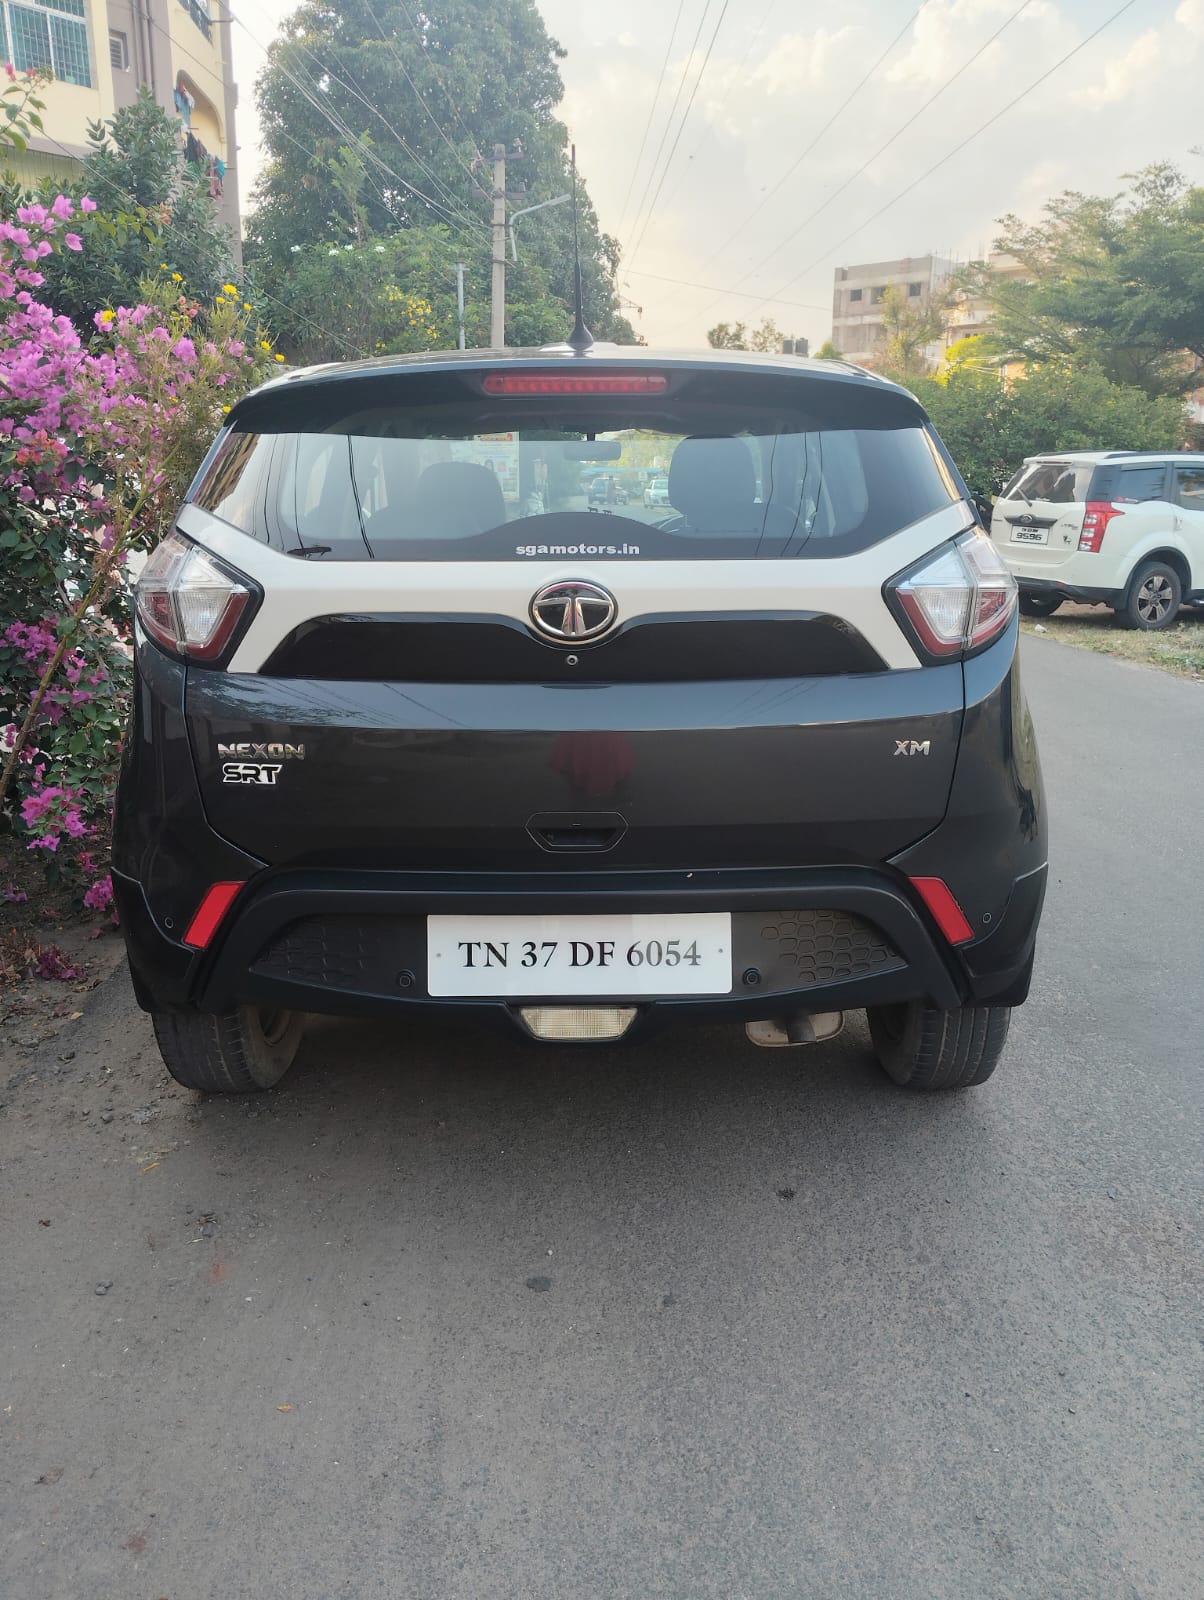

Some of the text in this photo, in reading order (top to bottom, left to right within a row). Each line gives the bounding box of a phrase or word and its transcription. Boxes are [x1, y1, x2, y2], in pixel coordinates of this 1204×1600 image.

[515, 543, 640, 556] sgamotors.in
[217, 743, 304, 760] NEXON
[893, 740, 930, 756] XM
[222, 762, 283, 785] SRT
[458, 939, 702, 967] TN 37 DF 6054
